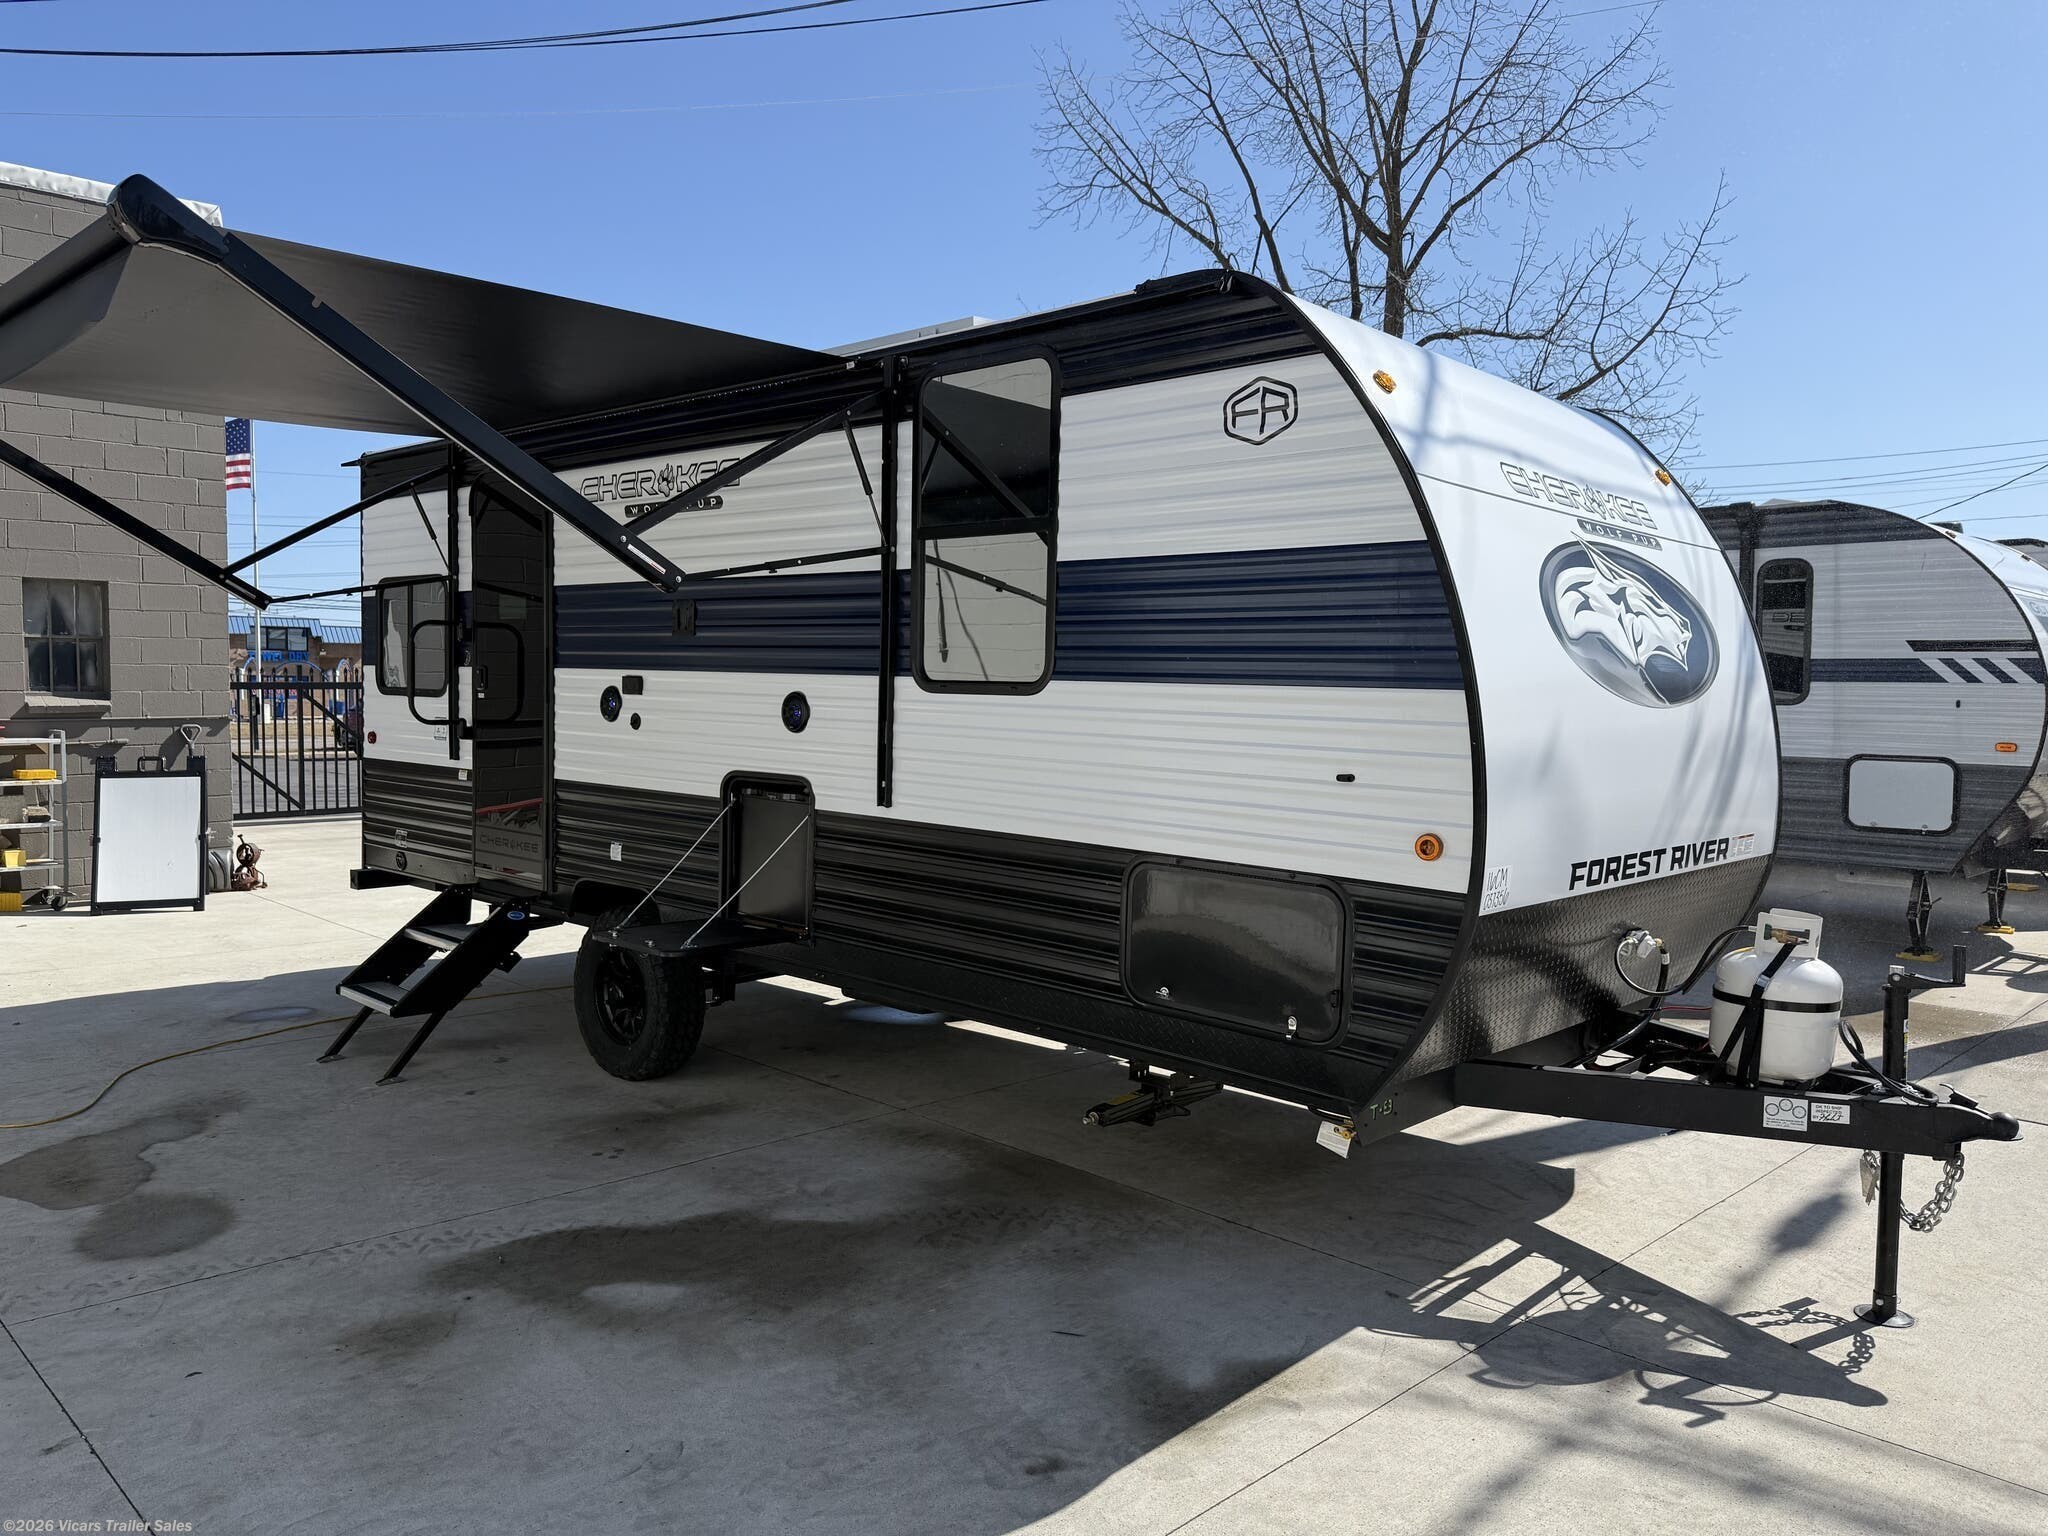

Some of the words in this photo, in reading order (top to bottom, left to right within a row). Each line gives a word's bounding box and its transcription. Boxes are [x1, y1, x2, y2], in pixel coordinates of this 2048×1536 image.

[1499, 461, 1658, 530] CHEROKEE
[1583, 521, 1623, 540] WOLF
[1631, 533, 1657, 547] PUP
[1569, 847, 1667, 891] FOREST
[1670, 837, 1730, 872] RIVER
